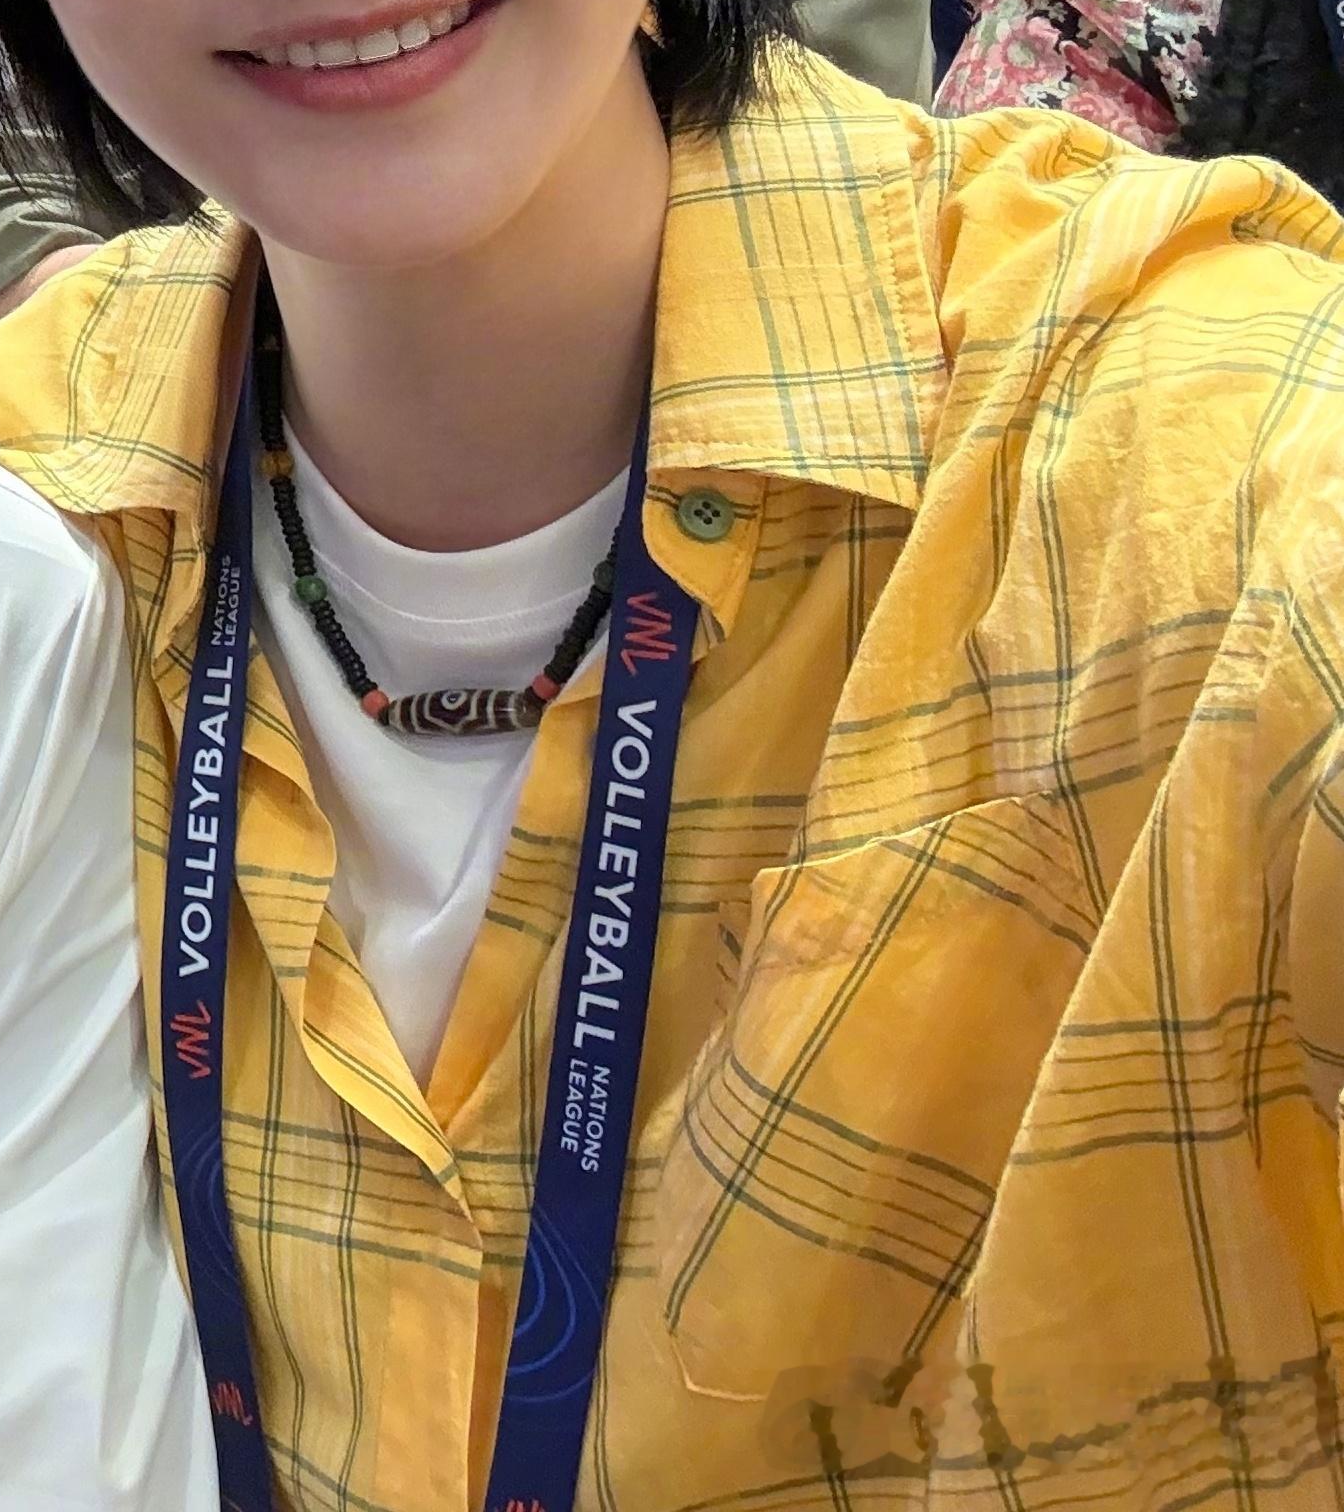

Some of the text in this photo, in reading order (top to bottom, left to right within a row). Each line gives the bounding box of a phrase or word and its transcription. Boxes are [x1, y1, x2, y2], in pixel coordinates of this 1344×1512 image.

[210, 555, 233, 647] NATIONS
[224, 565, 242, 648] LEAGUE
[178, 655, 234, 978] VOLLEYBALL
[572, 698, 659, 1049] VOLLEYBALL
[560, 1058, 586, 1152] LEAGUE
[580, 1064, 612, 1173] NATIONS
